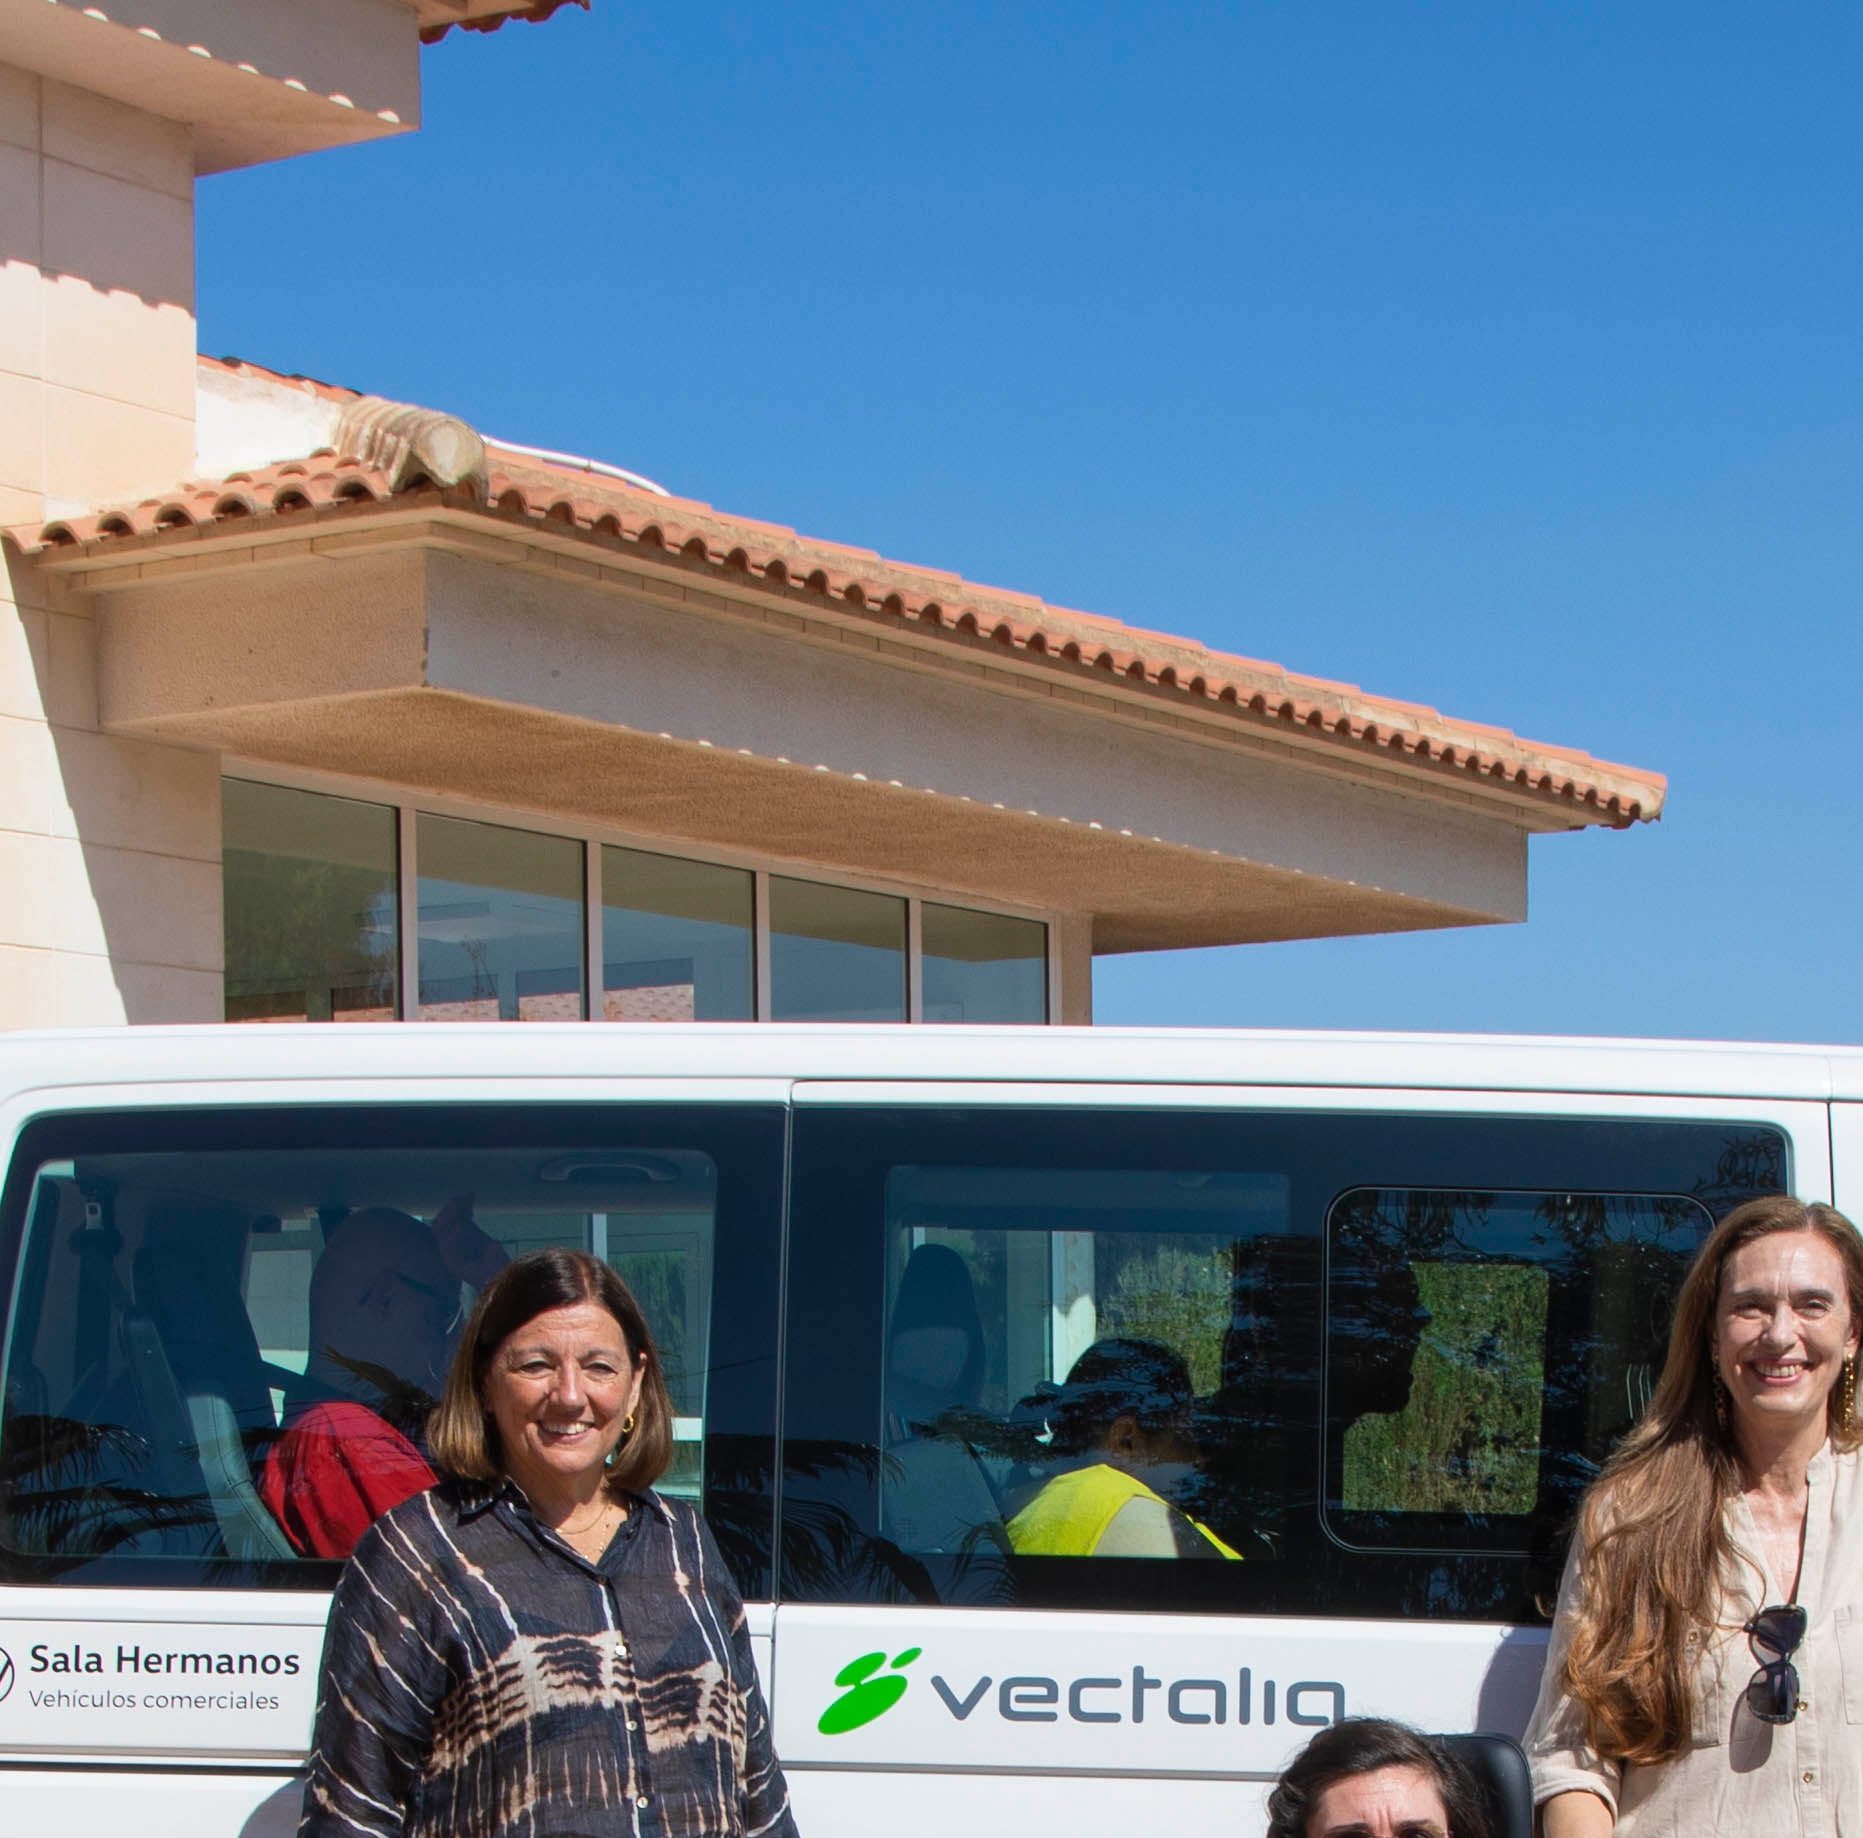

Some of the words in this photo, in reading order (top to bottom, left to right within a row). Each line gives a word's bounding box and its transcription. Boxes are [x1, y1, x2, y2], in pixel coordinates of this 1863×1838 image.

[30, 1644, 104, 1674] Sala
[116, 1645, 300, 1675] Hermanos
[29, 1688, 137, 1709] Vehículos
[143, 1688, 280, 1710] comerciales
[930, 1665, 1346, 1727] vectalia
